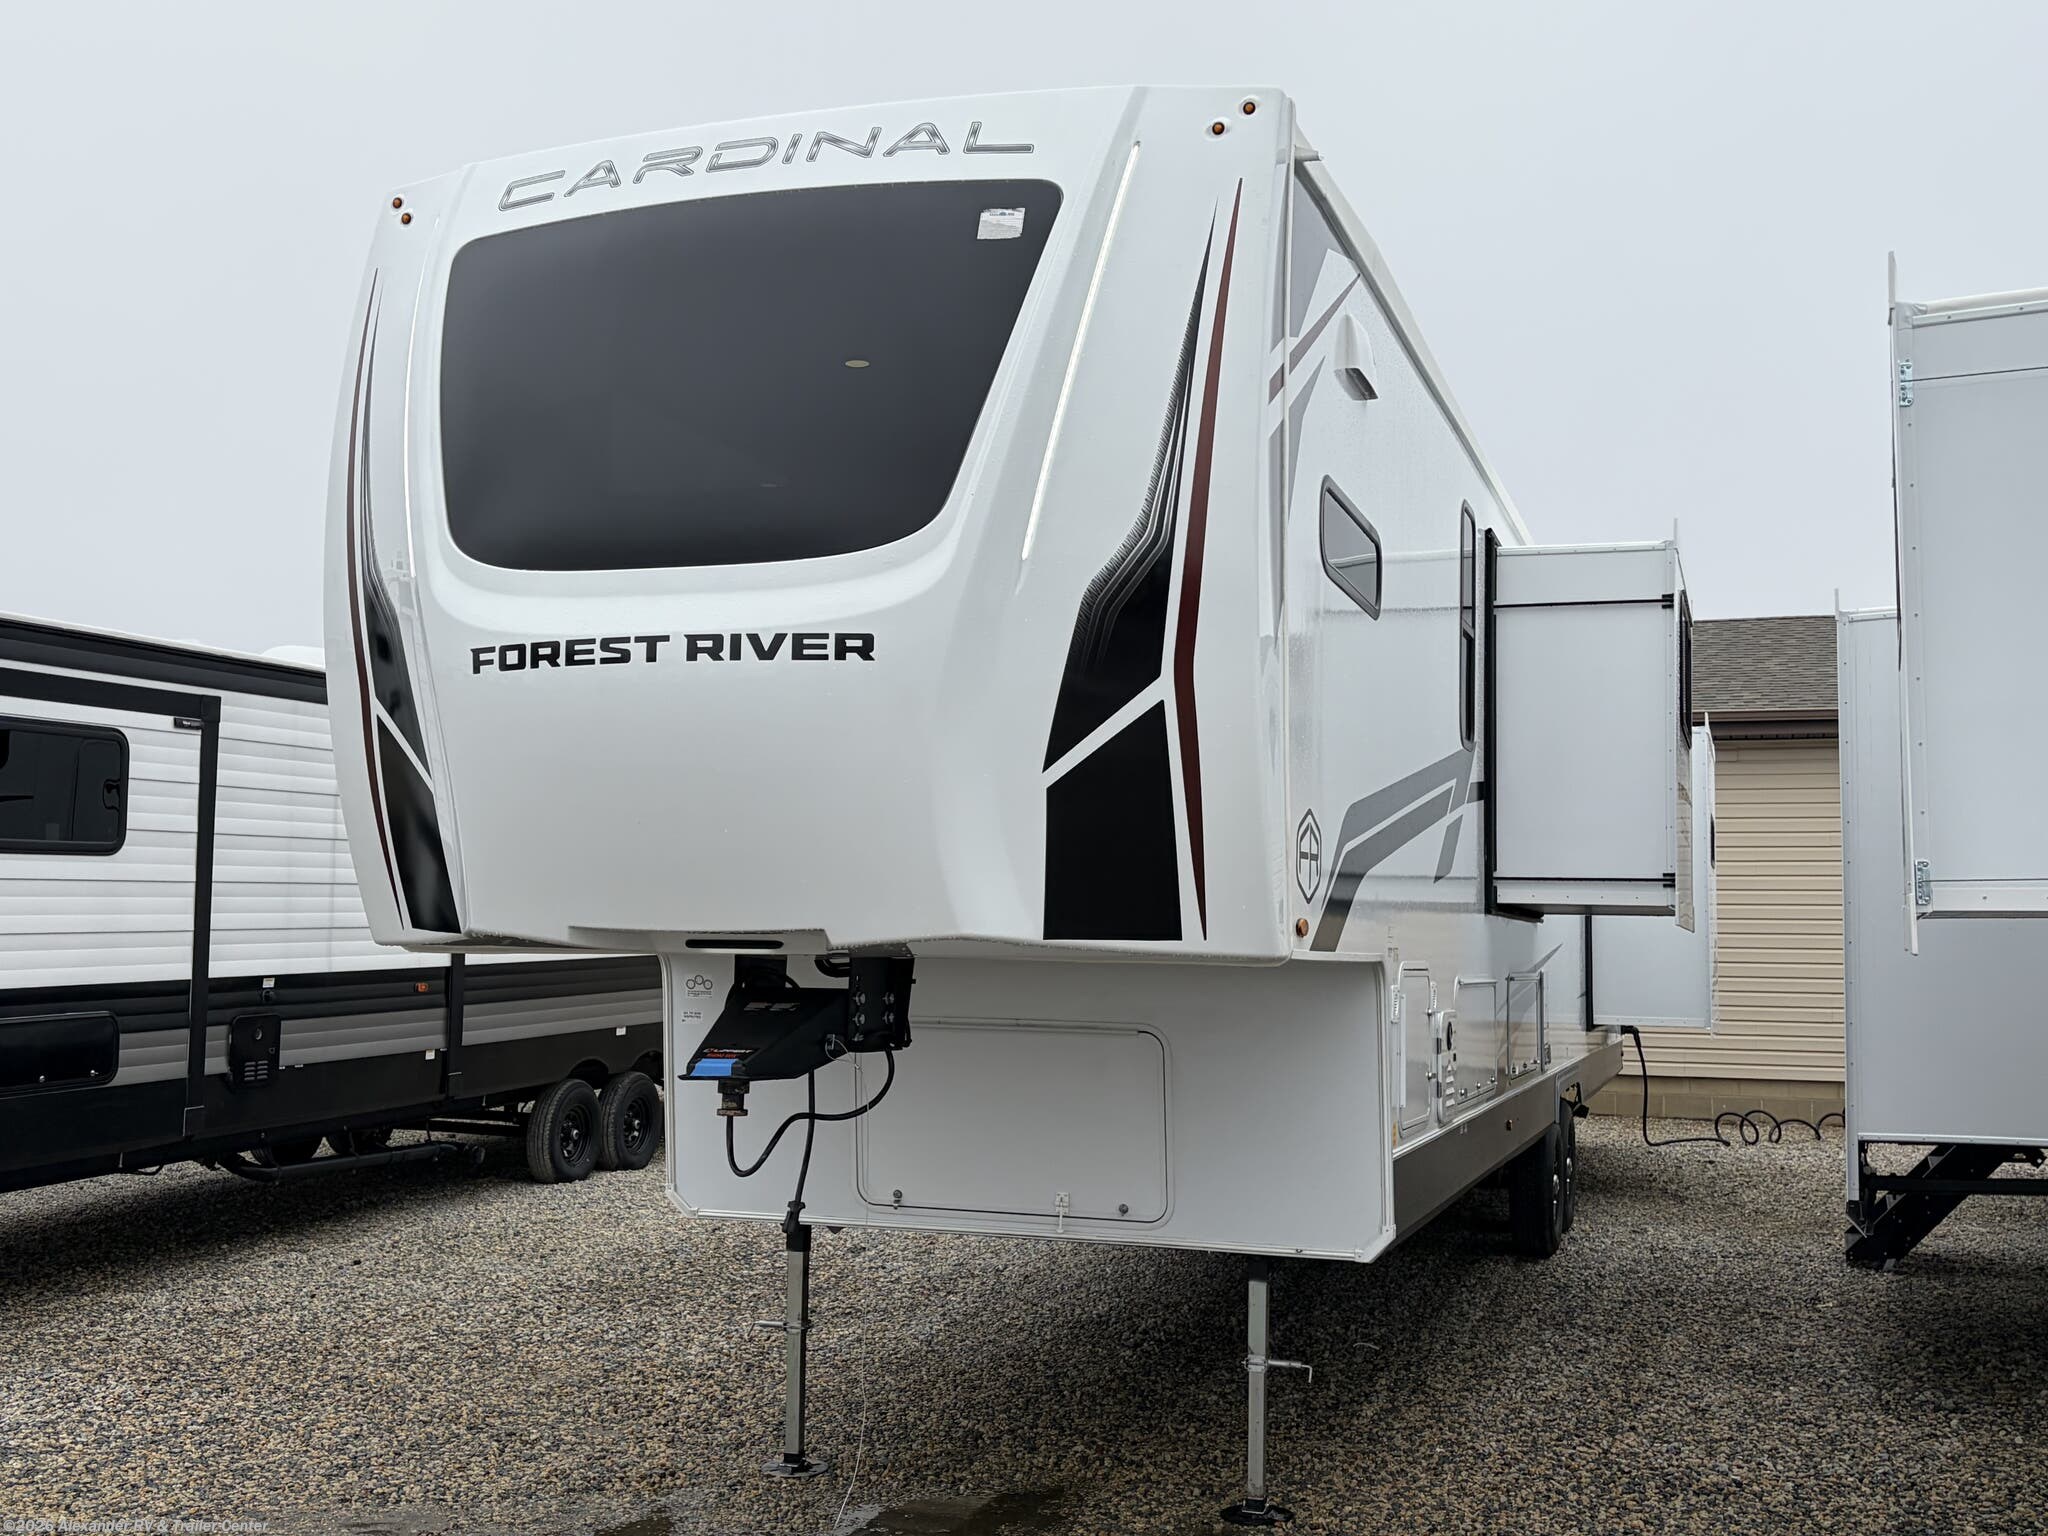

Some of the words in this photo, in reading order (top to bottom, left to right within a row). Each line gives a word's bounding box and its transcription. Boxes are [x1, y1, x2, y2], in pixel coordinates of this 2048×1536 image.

[498, 121, 1035, 211] CARDINAL
[471, 635, 670, 674] FOREST
[684, 633, 875, 661] RIVER
